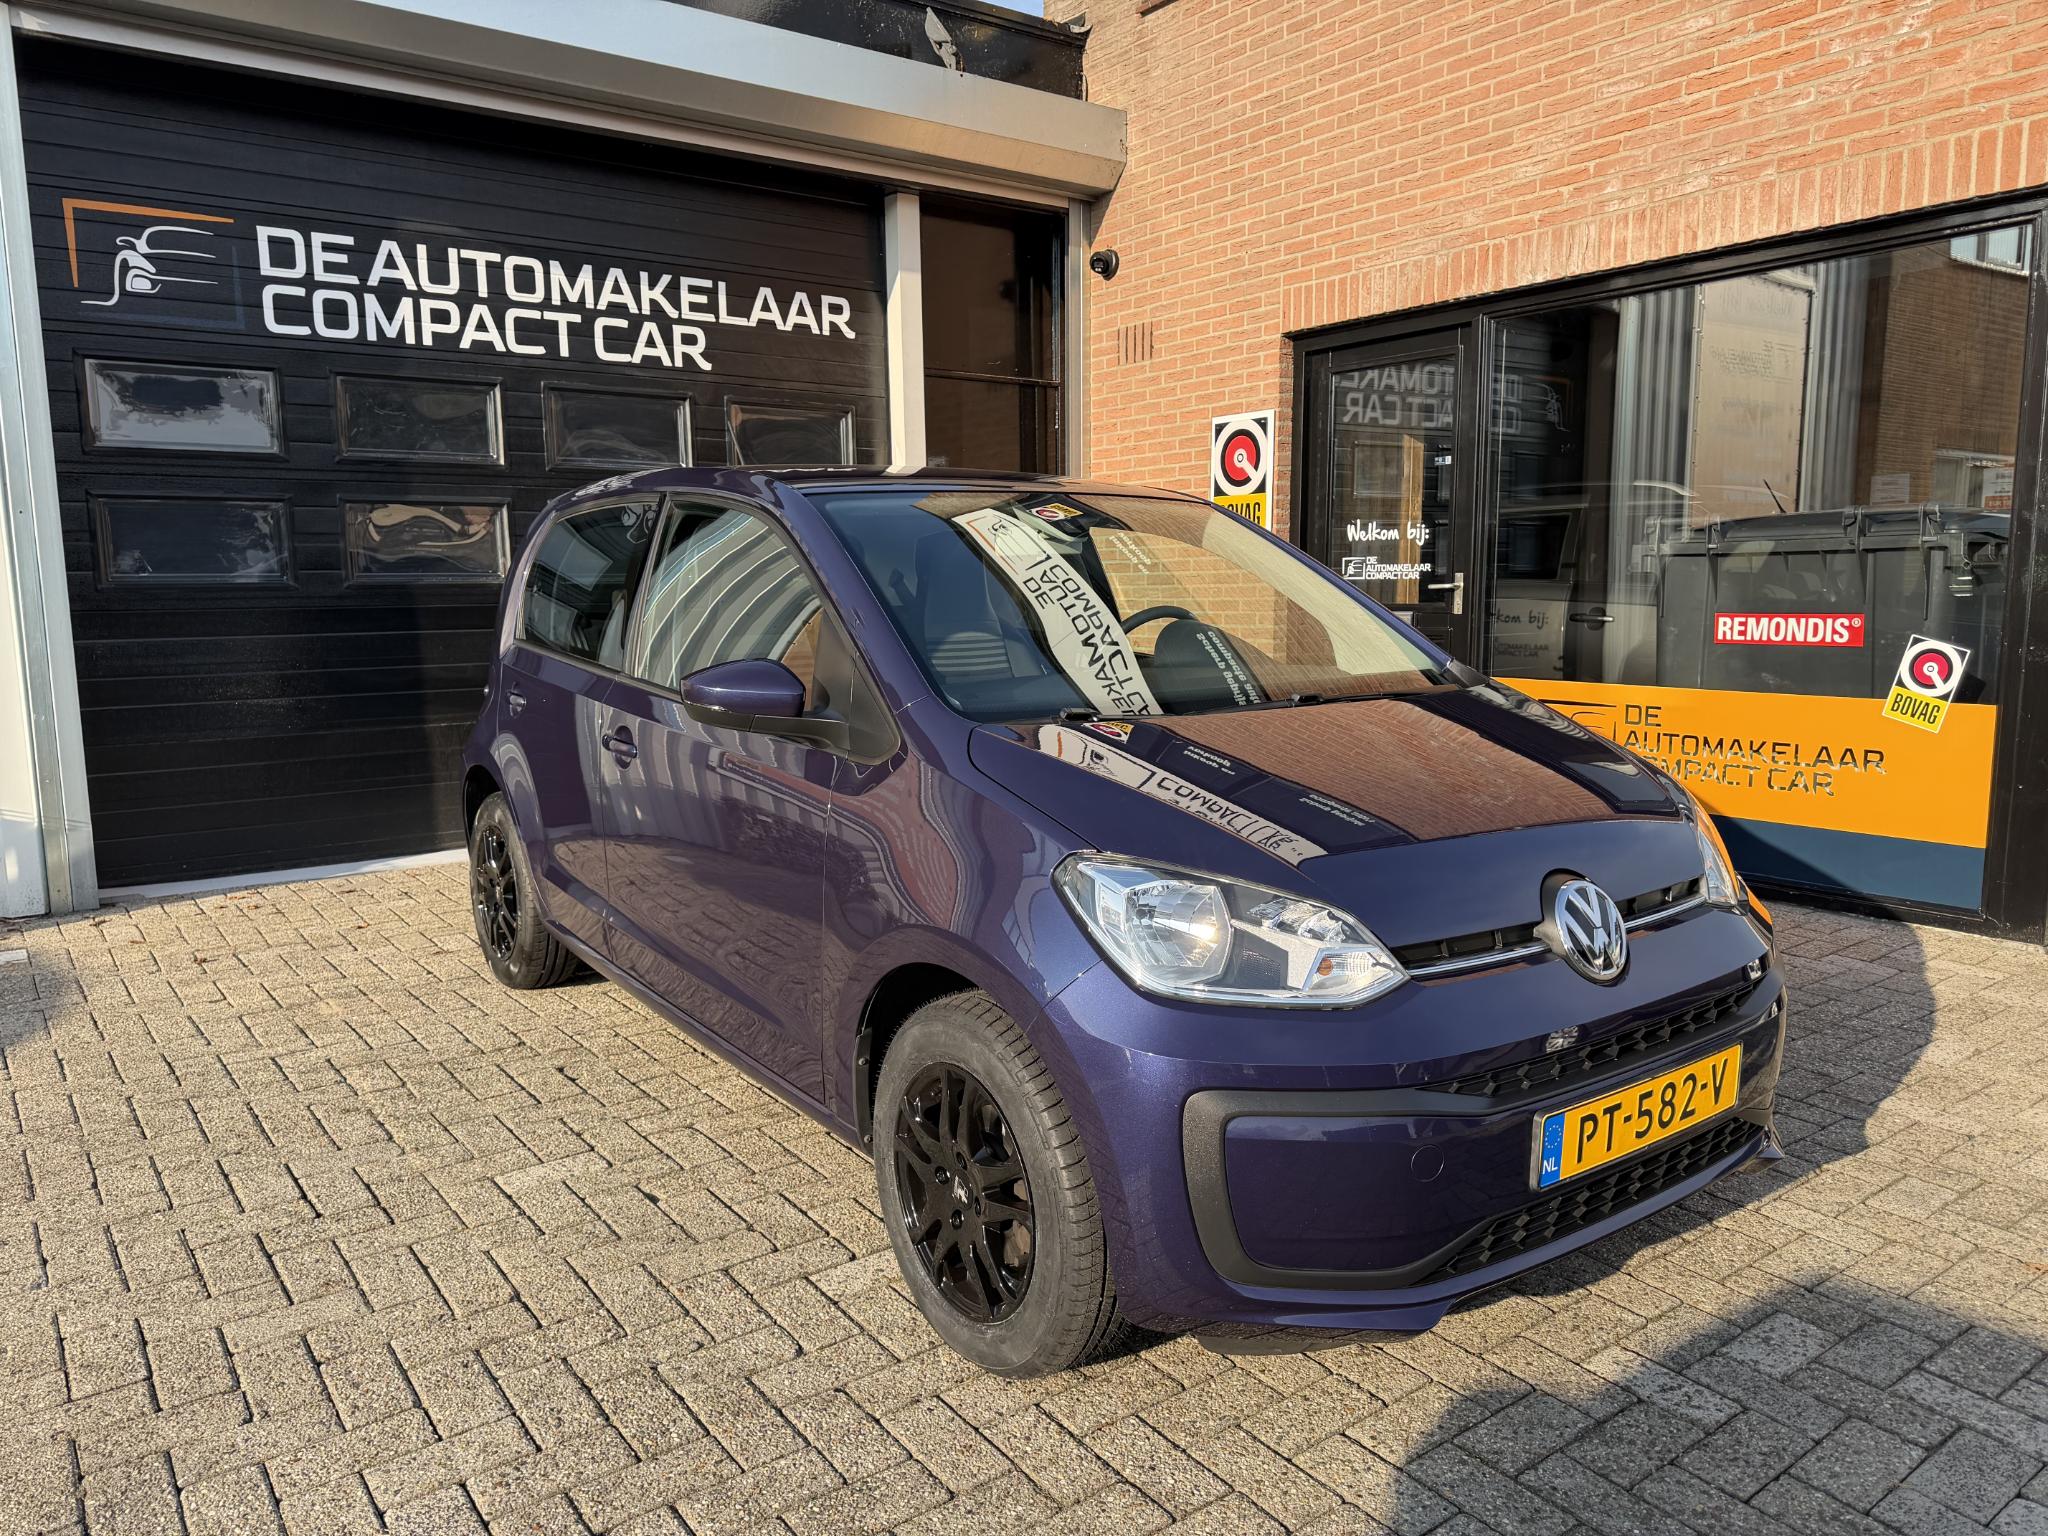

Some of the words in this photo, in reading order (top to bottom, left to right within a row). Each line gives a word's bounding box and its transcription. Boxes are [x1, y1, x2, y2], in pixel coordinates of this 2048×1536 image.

[256, 225, 360, 285] DE
[367, 239, 856, 339] AUTOMAKELAAR
[262, 284, 582, 357] COMPACT
[594, 316, 713, 371] CAR
[1221, 502, 1261, 525] VAG
[1346, 518, 1400, 542] Welkom
[1407, 521, 1430, 546] bij:
[1366, 556, 1378, 565] DE
[1366, 563, 1432, 572] AUTOMAKELAAR
[1365, 571, 1403, 580] COMPACT
[1403, 572, 1420, 580] CAR
[1624, 703, 1662, 727] DE
[1891, 693, 1941, 725] BOVAG
[1623, 730, 1888, 775] AUTOMAKELAAR
[1641, 756, 1761, 788] MPACT
[1767, 768, 1835, 797] CAR
[1576, 1057, 1729, 1165] PT-582-V
[1542, 1158, 1559, 1175] NL
